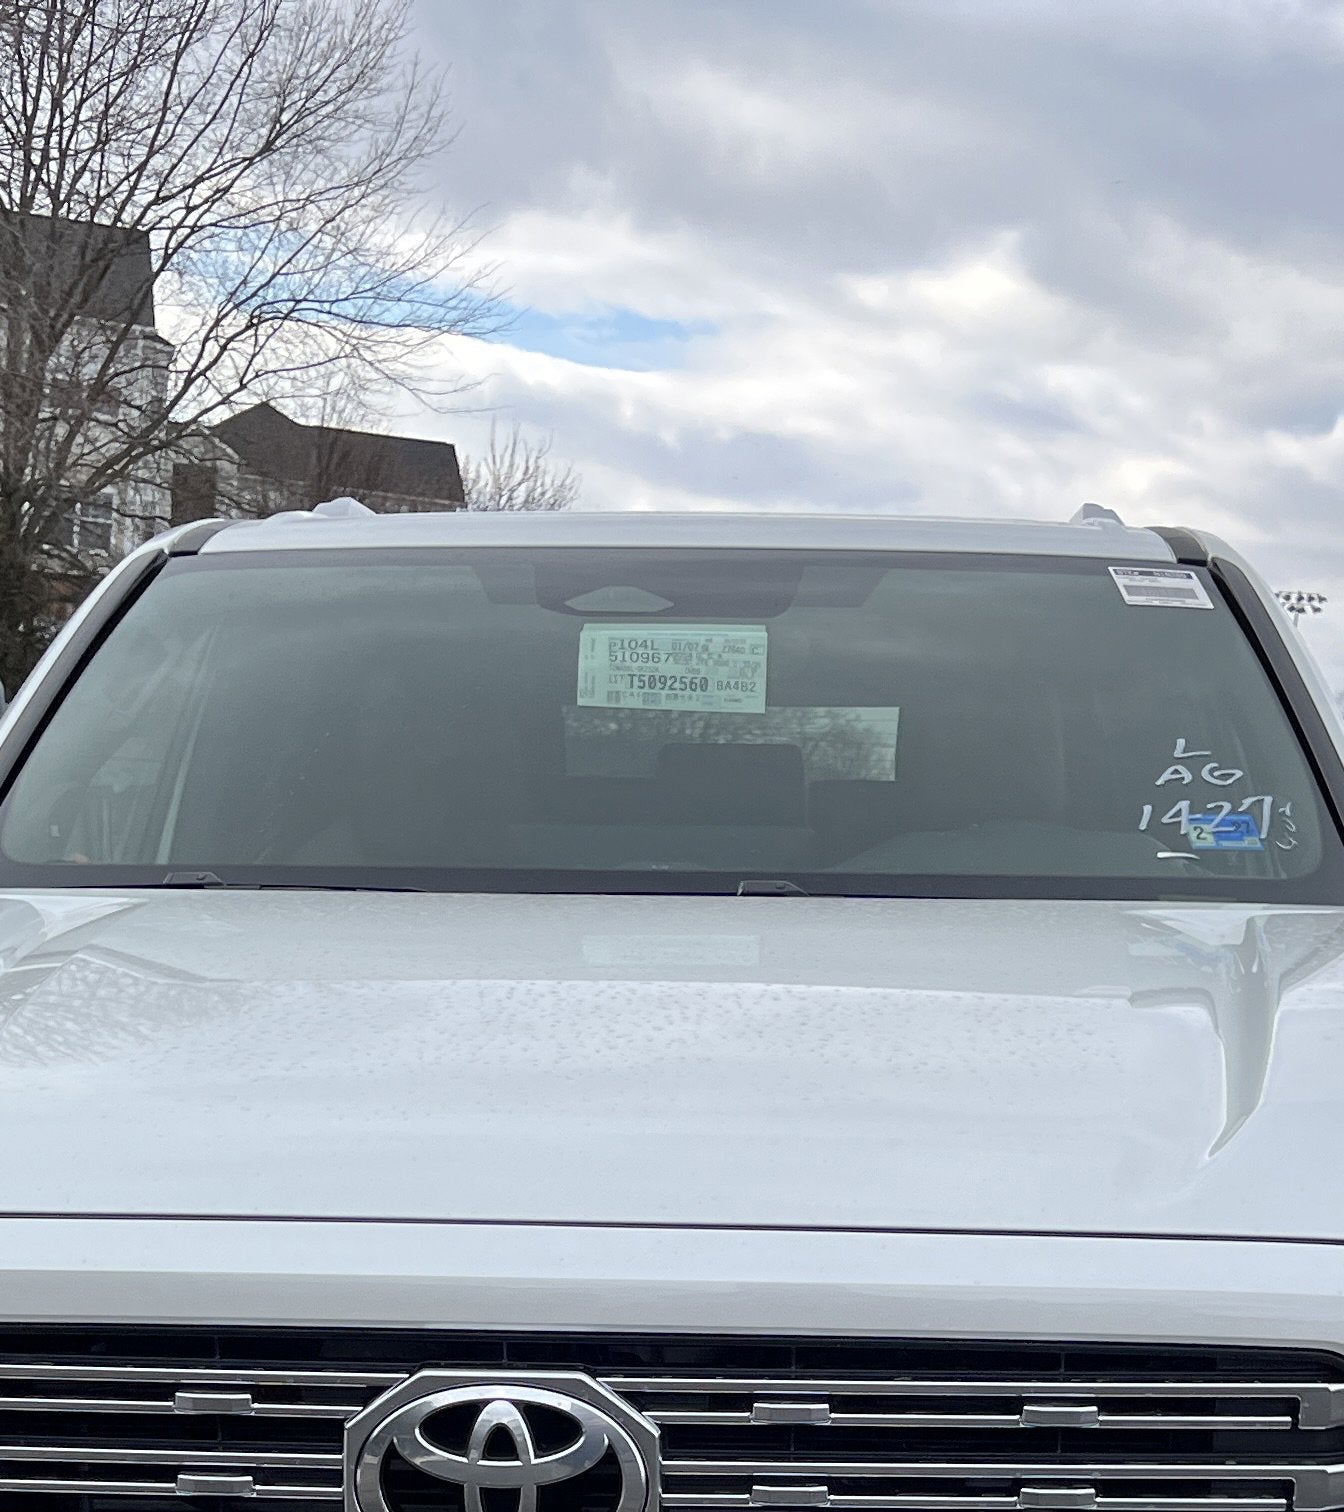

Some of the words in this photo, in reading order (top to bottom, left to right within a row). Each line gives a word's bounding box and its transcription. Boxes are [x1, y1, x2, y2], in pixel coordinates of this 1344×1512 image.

[627, 673, 709, 693] T5092560
[1173, 737, 1212, 758] L
[1138, 795, 1274, 840] 1427
